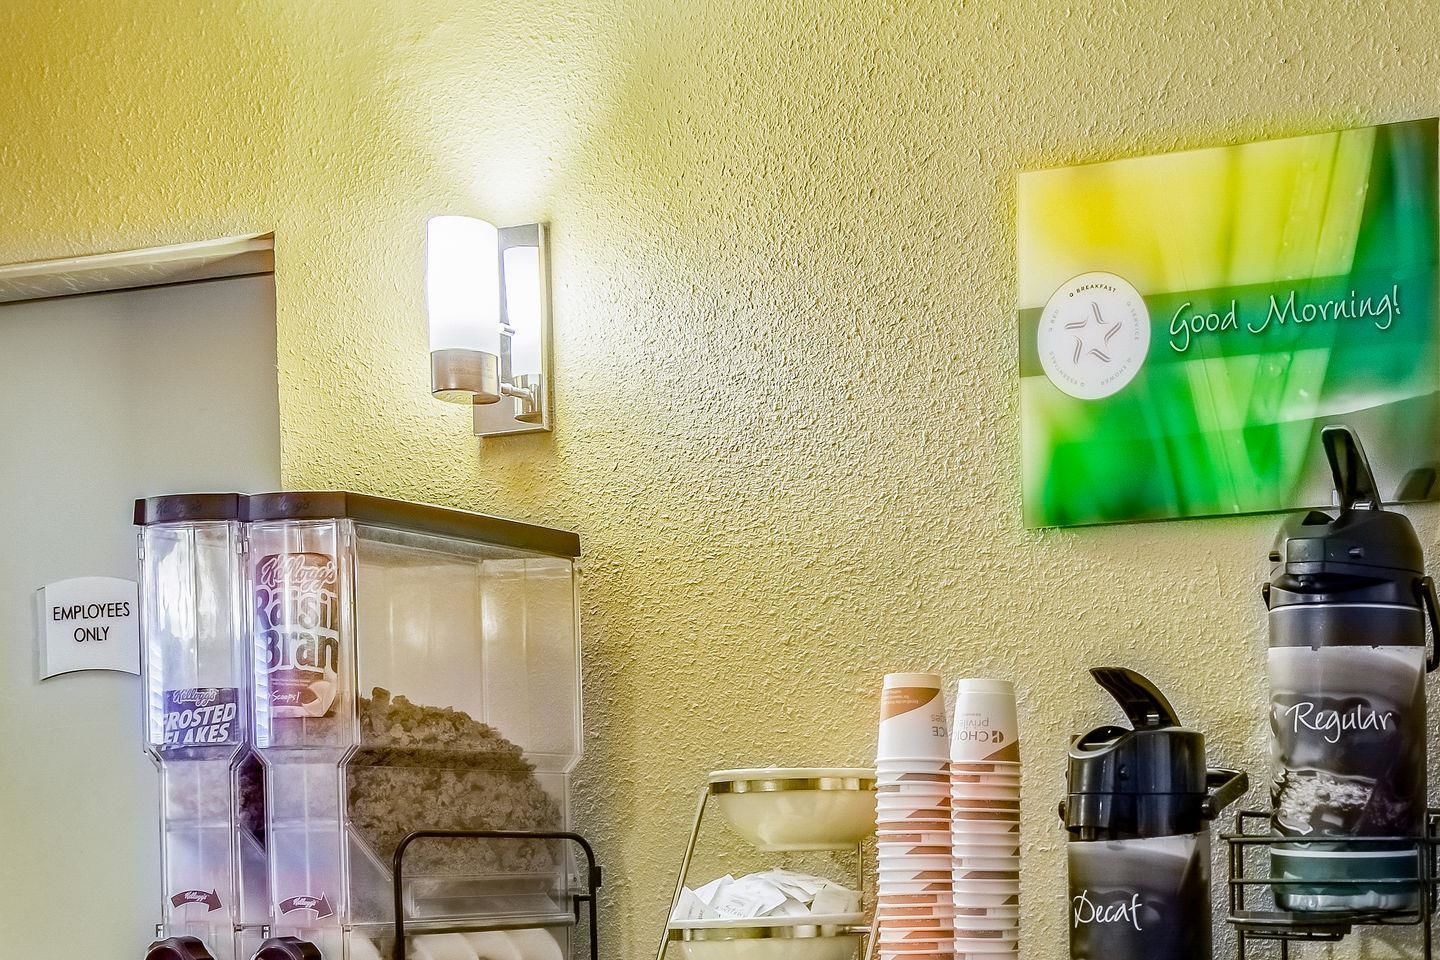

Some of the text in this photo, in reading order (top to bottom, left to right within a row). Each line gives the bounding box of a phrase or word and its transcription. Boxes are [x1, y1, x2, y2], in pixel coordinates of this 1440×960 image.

[1076, 284, 1116, 293] BREAKFAST
[1169, 284, 1400, 352] Good Morning!
[261, 554, 337, 593] Kellogg's
[52, 602, 130, 621] EMPLOYEES
[73, 626, 110, 643] ONLY
[1285, 701, 1393, 744] Regular
[1073, 889, 1143, 931] Decaf
